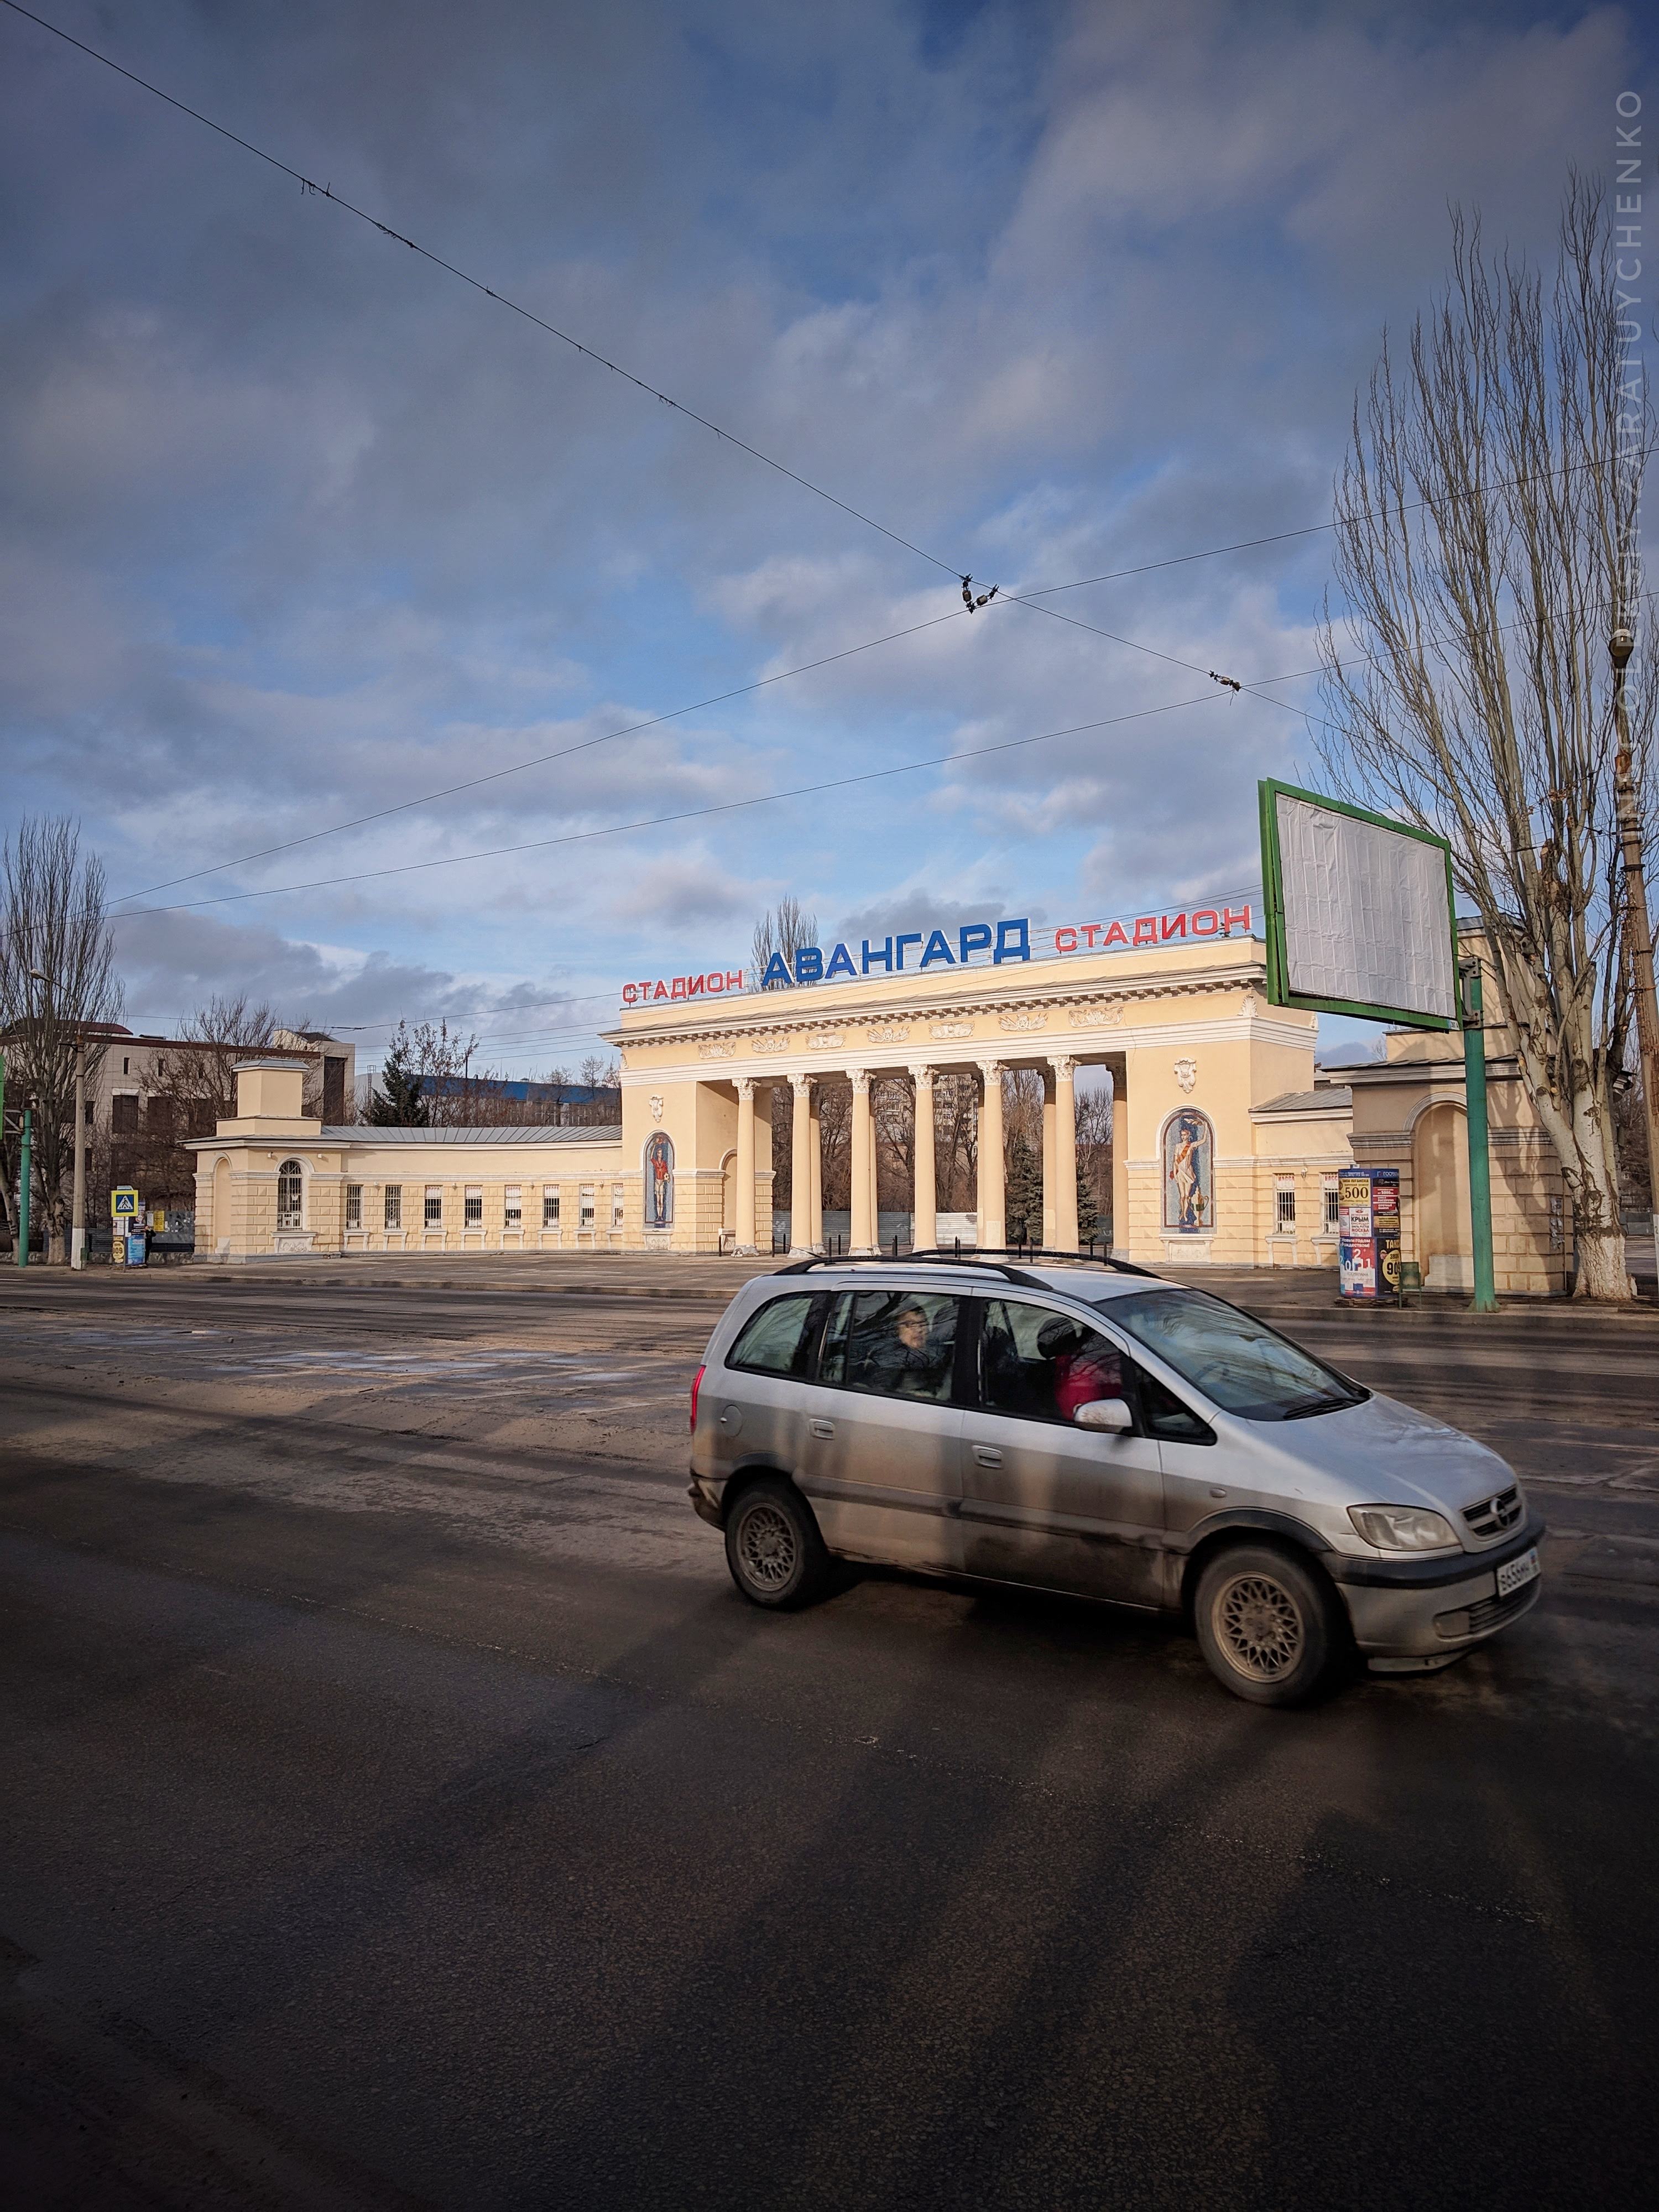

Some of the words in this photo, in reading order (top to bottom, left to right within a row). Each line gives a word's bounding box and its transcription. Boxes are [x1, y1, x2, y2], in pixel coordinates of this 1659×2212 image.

[623, 970, 743, 1003] СТАДИОН
[761, 918, 1031, 986] АВАНГАРД
[1055, 905, 1252, 952] СТАДИОН
[1345, 1187, 1369, 1199] 500
